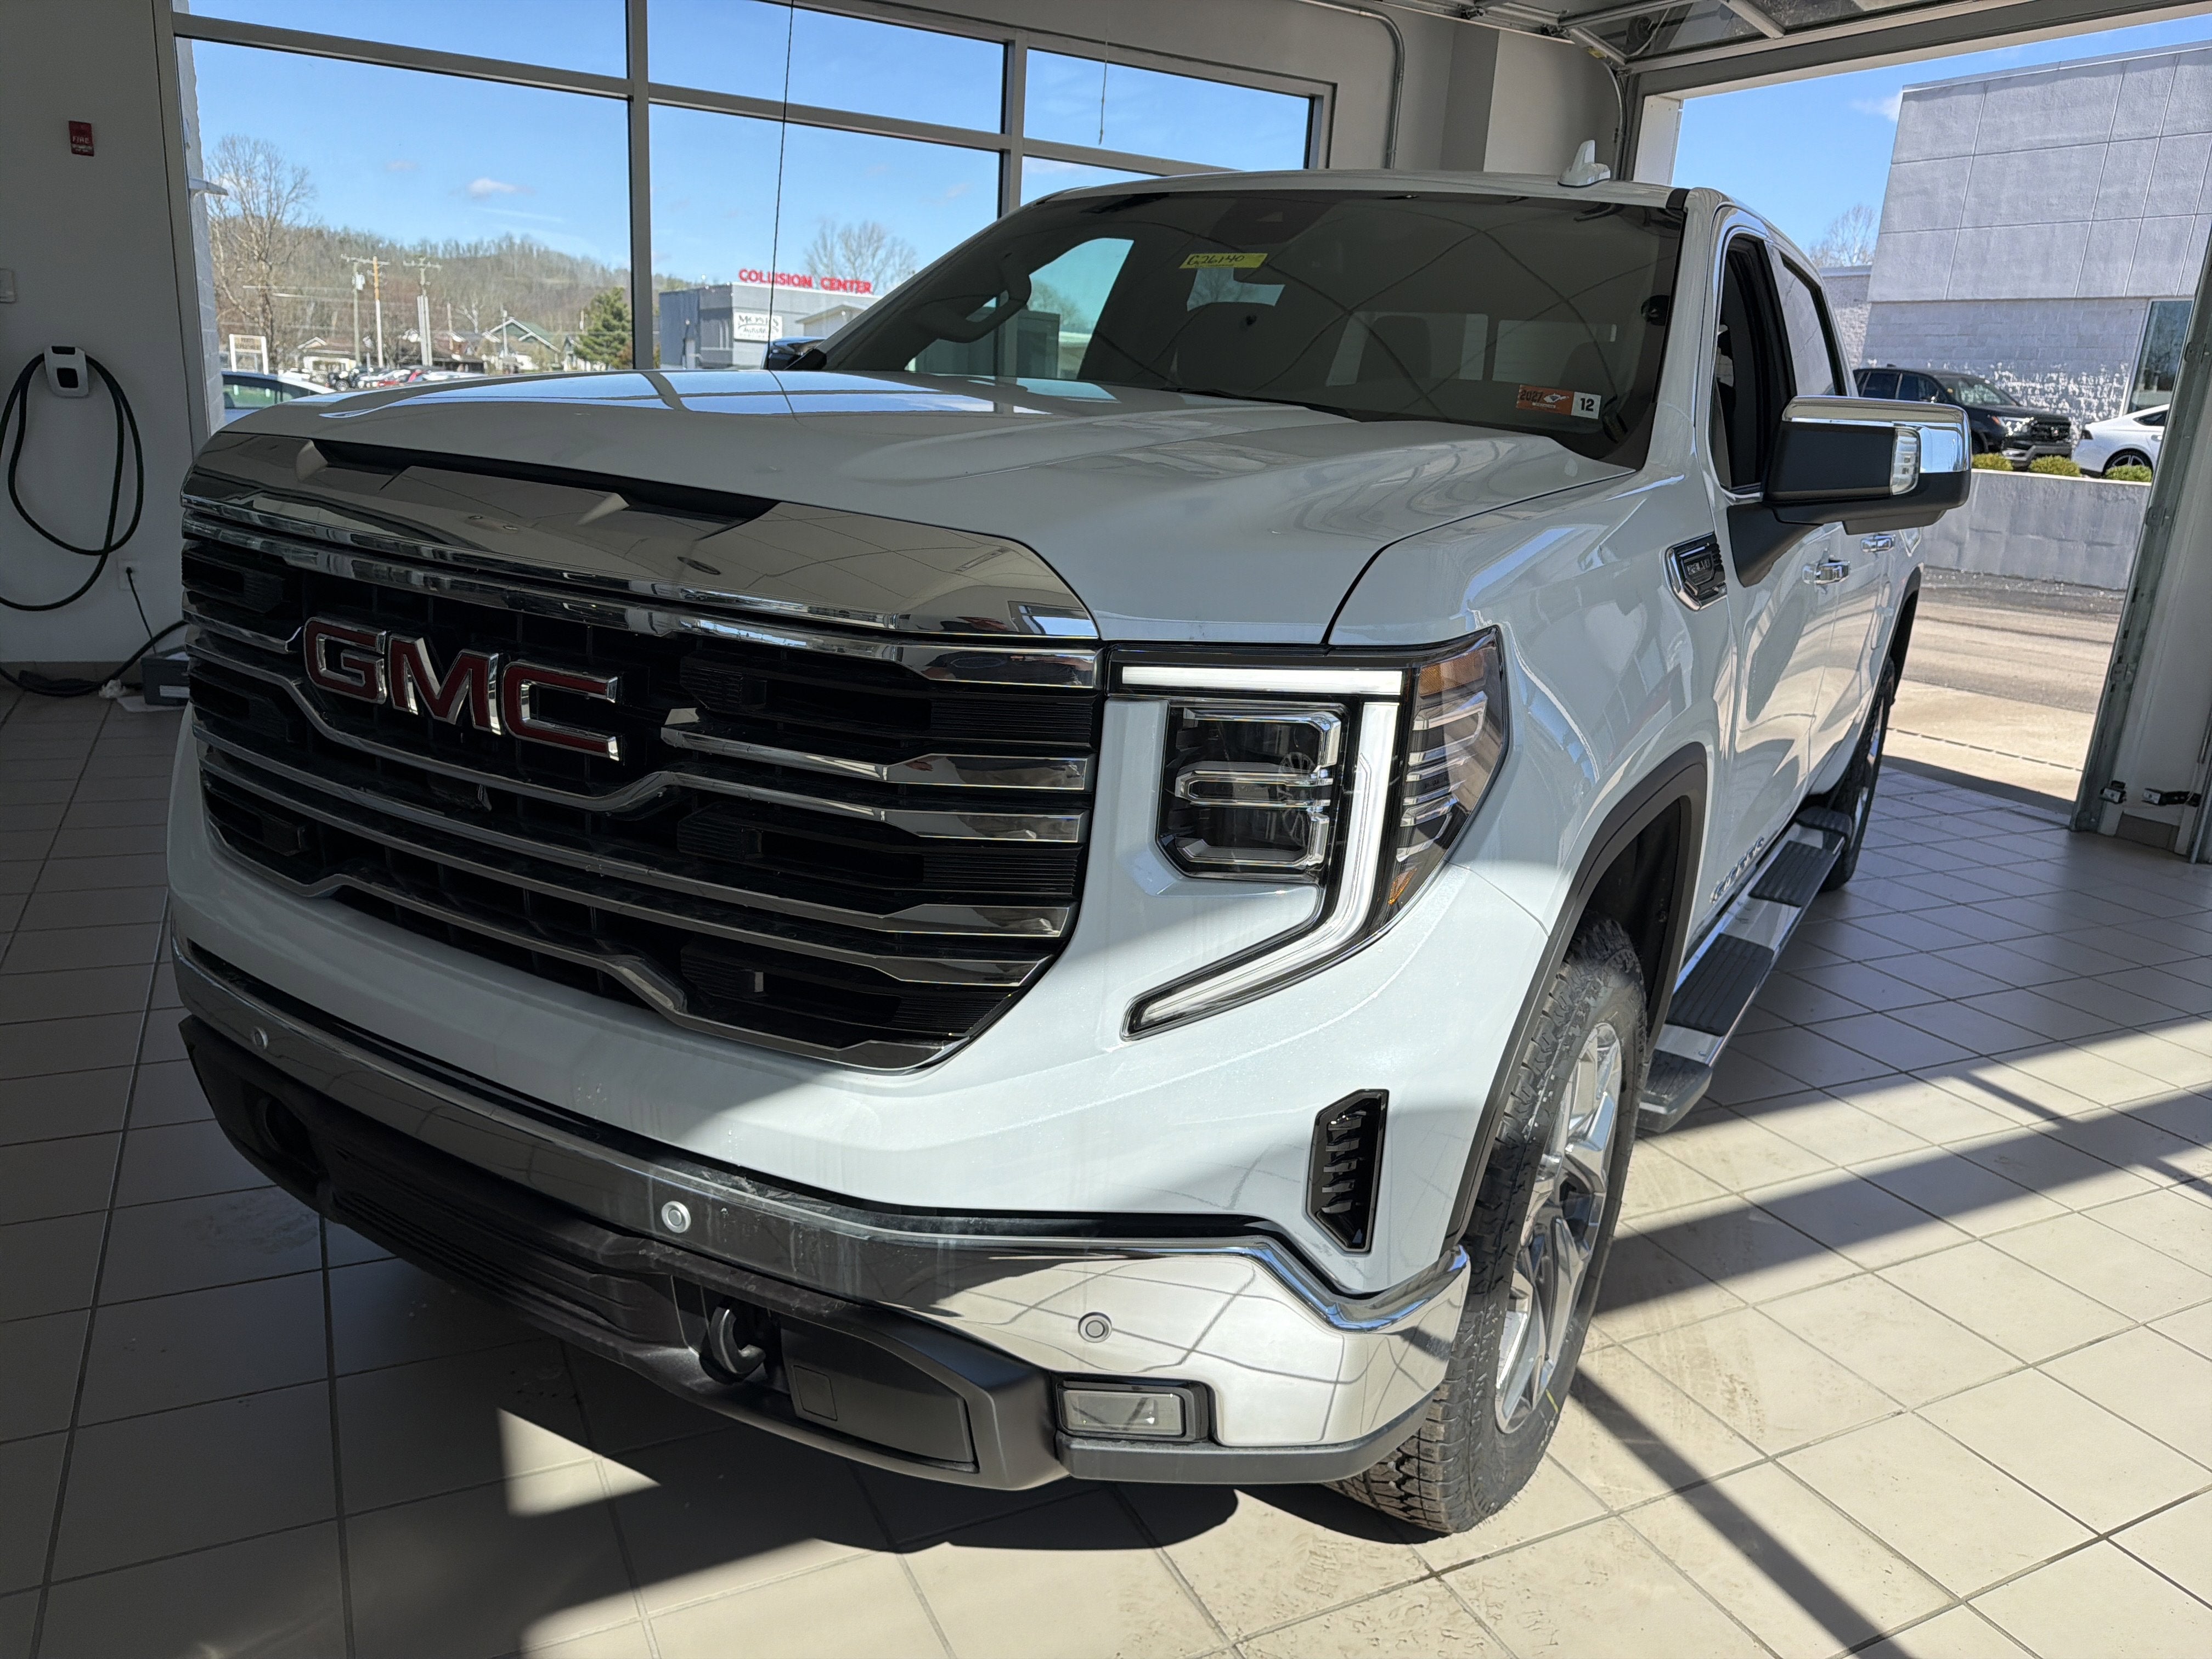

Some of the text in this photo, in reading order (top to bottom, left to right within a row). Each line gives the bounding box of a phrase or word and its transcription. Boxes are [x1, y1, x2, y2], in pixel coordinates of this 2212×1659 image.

[72, 136, 89, 144] FIRE
[738, 269, 873, 294] COLLISION CENTER
[1520, 389, 1543, 403] 2027
[1580, 398, 1594, 411] 12
[303, 617, 619, 761] GMC
